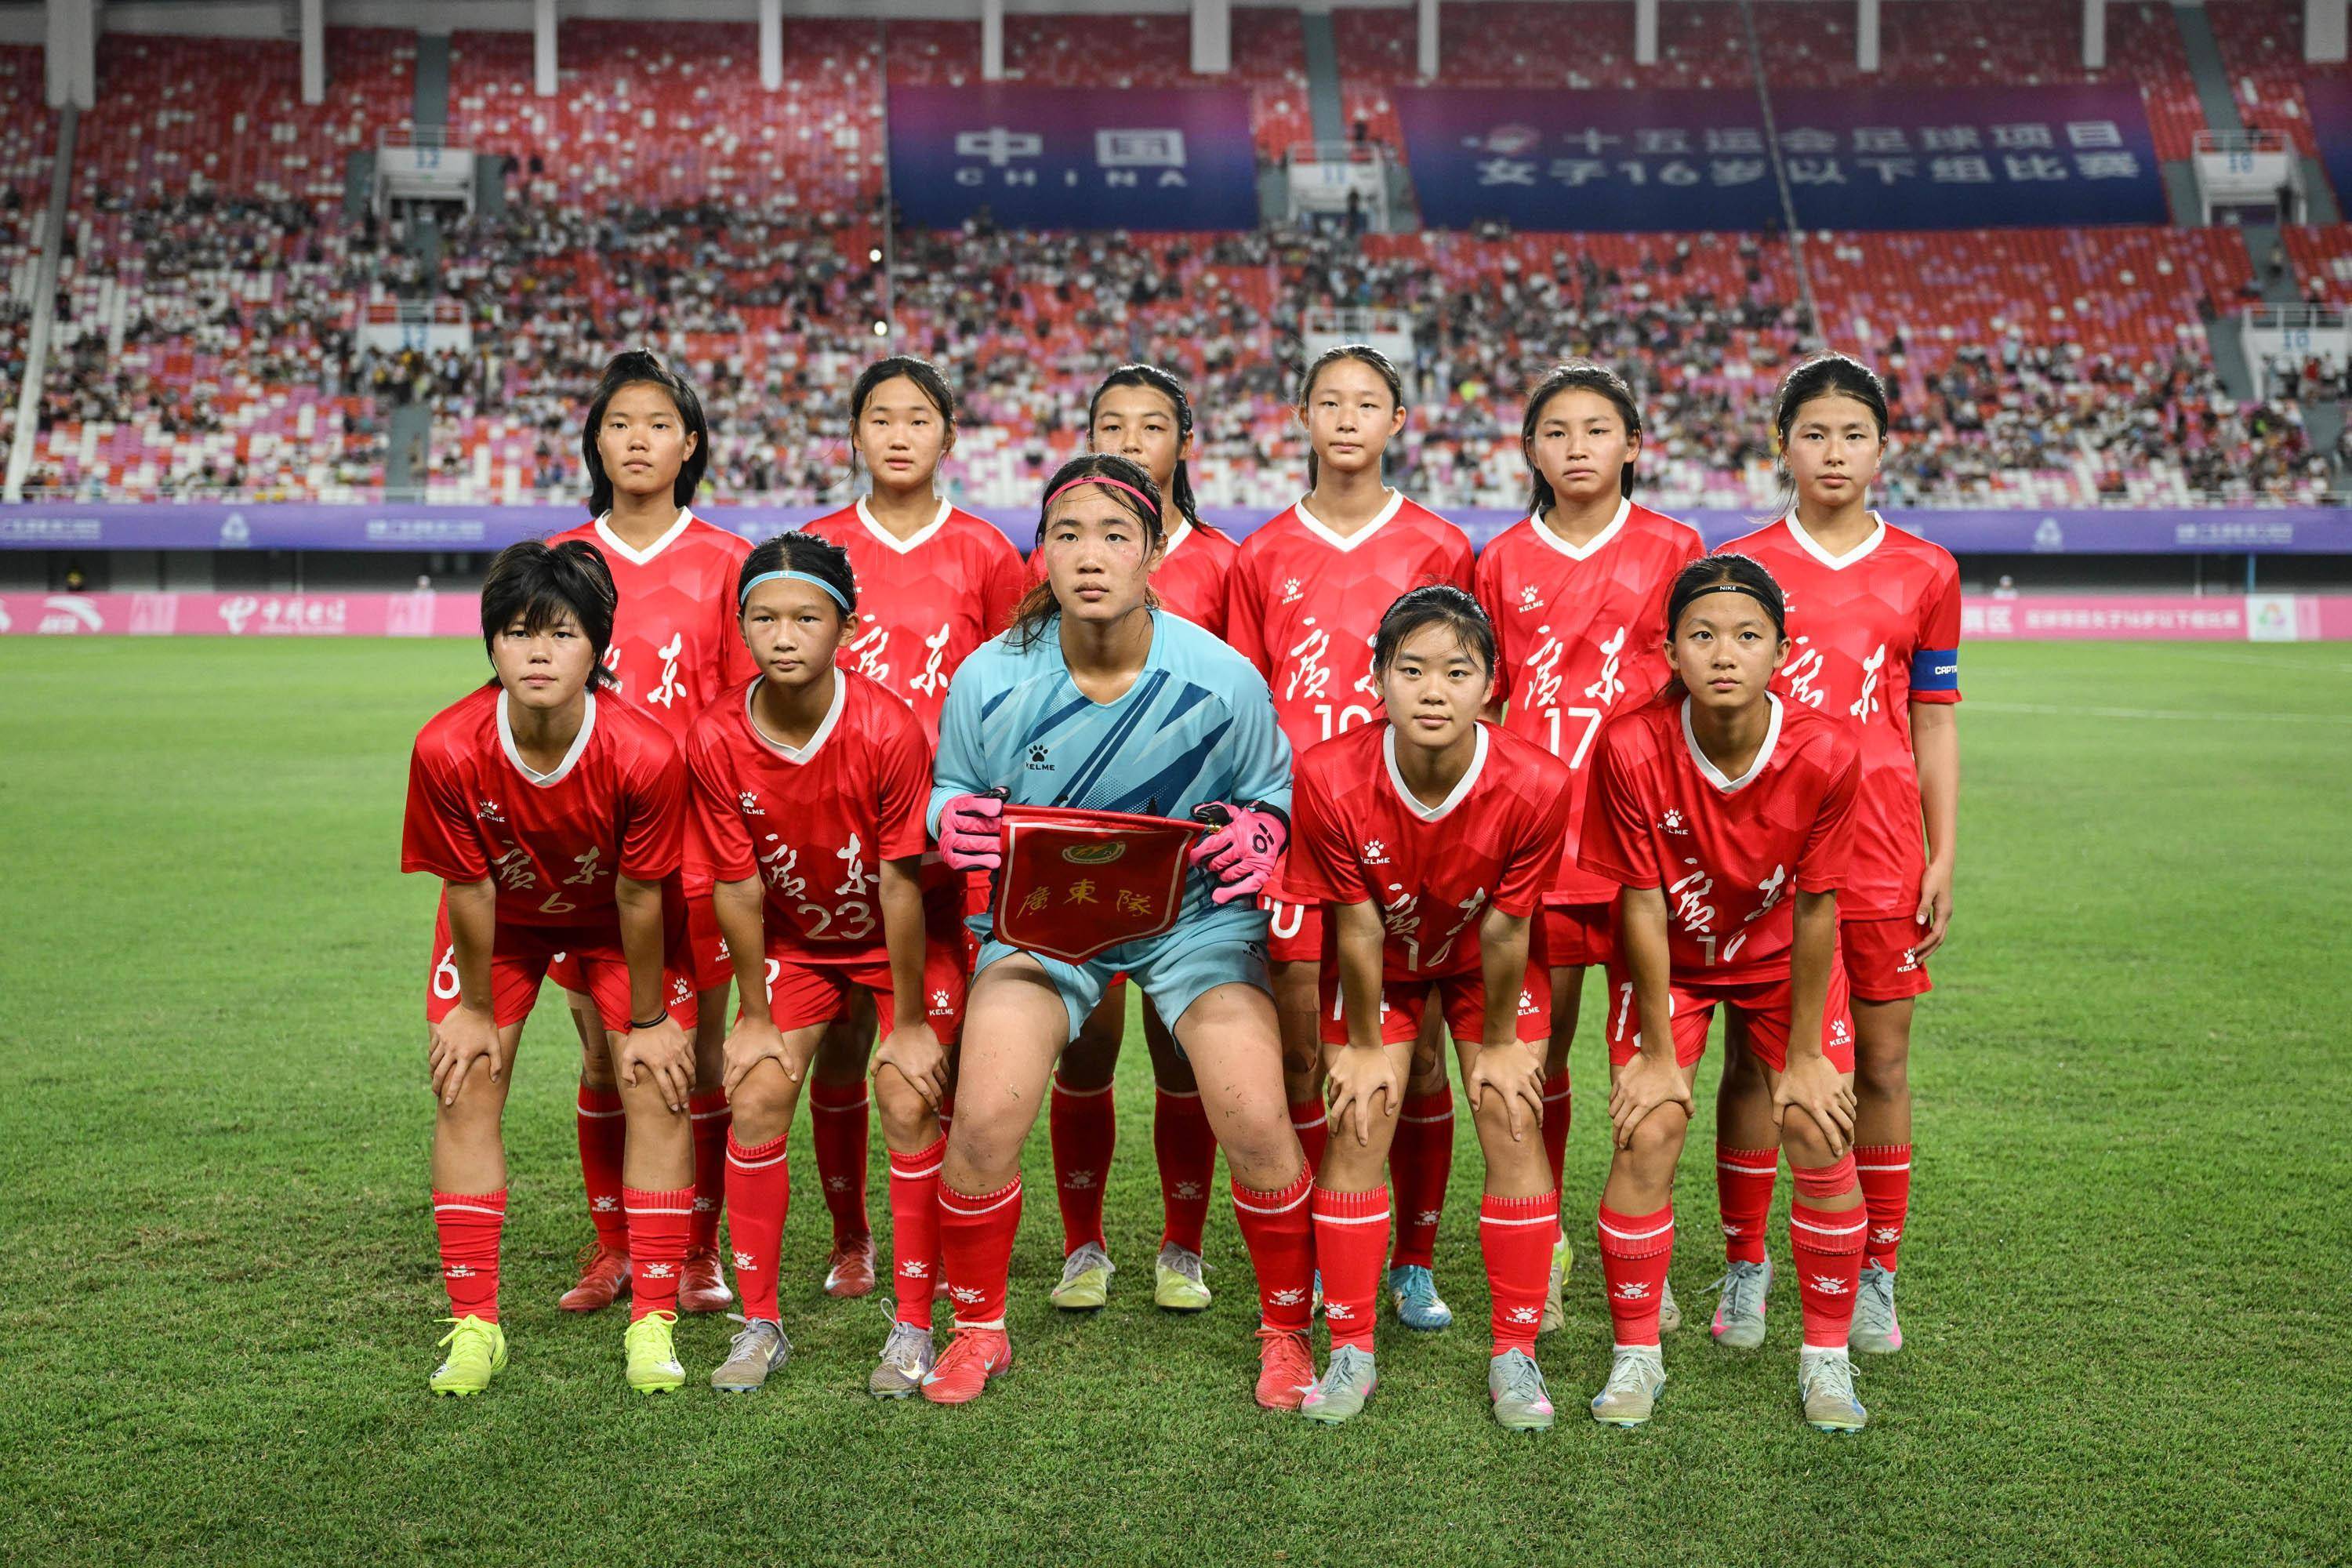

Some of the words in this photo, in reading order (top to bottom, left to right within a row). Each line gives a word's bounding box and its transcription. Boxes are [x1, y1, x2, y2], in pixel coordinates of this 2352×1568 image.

[955, 127, 1185, 167] 中国
[1477, 151, 2140, 186] 女子16岁以下组比赛
[955, 168, 1187, 187] CHINA
[1519, 600, 1544, 613] KELME
[1544, 706, 1602, 769] 17
[1025, 762, 1056, 771] KELME
[476, 812, 506, 822] KELME
[538, 891, 576, 914] 6
[1016, 878, 1153, 920] 廣東隊
[797, 901, 877, 940] 23
[433, 943, 461, 1000] 6
[1517, 1006, 1541, 1016] ELME
[899, 1270, 928, 1279] KELME
[1613, 1291, 1650, 1300] KELME
[1810, 1283, 1849, 1294] KELME
[1506, 1316, 1538, 1325] KELME
